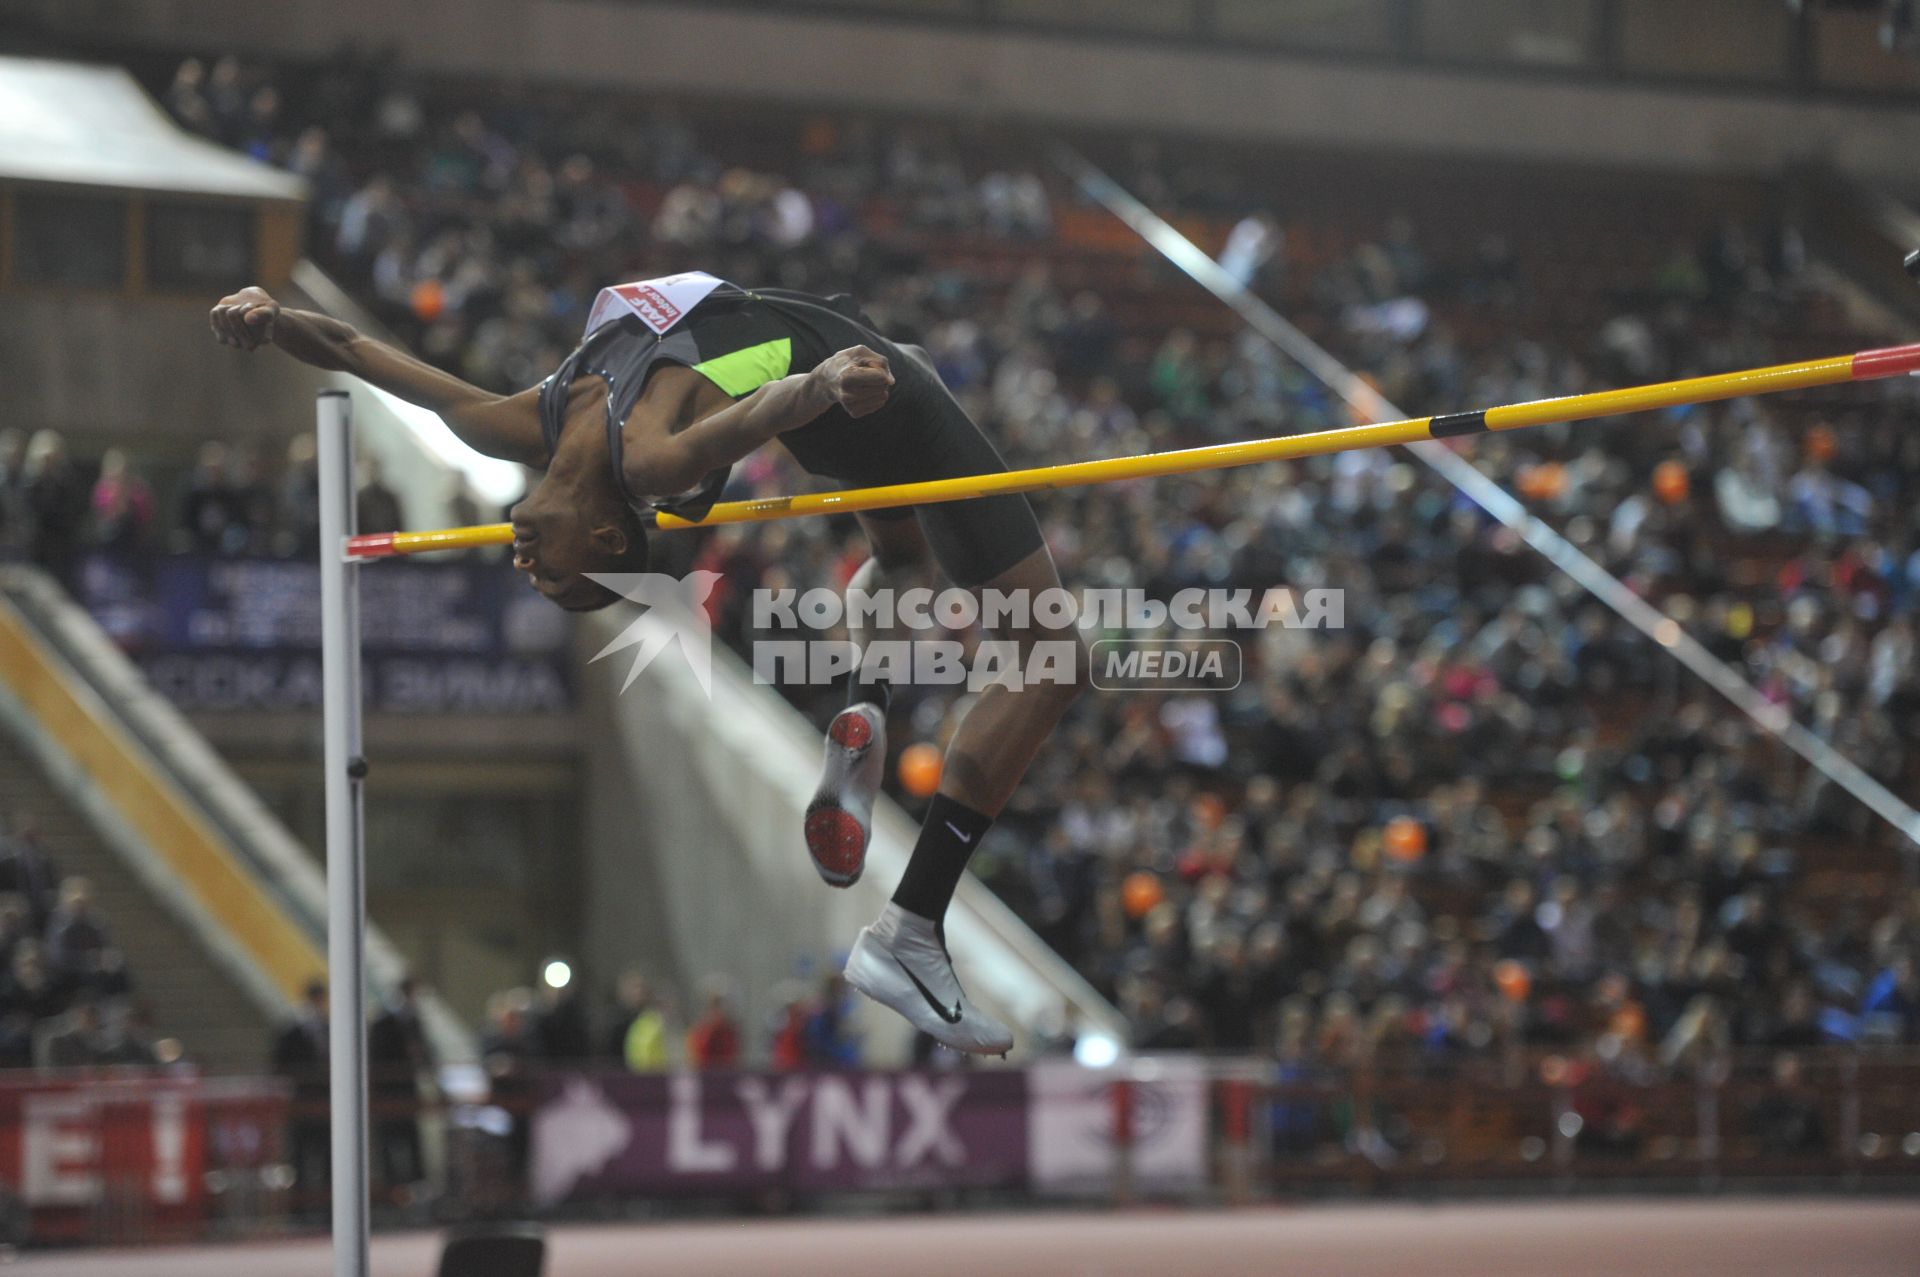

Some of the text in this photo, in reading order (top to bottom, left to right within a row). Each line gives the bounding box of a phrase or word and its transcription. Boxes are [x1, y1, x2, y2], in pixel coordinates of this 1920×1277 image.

[630, 299, 667, 325] IAAF
[647, 292, 678, 317] Indoor
[669, 1073, 968, 1172] LYNX
